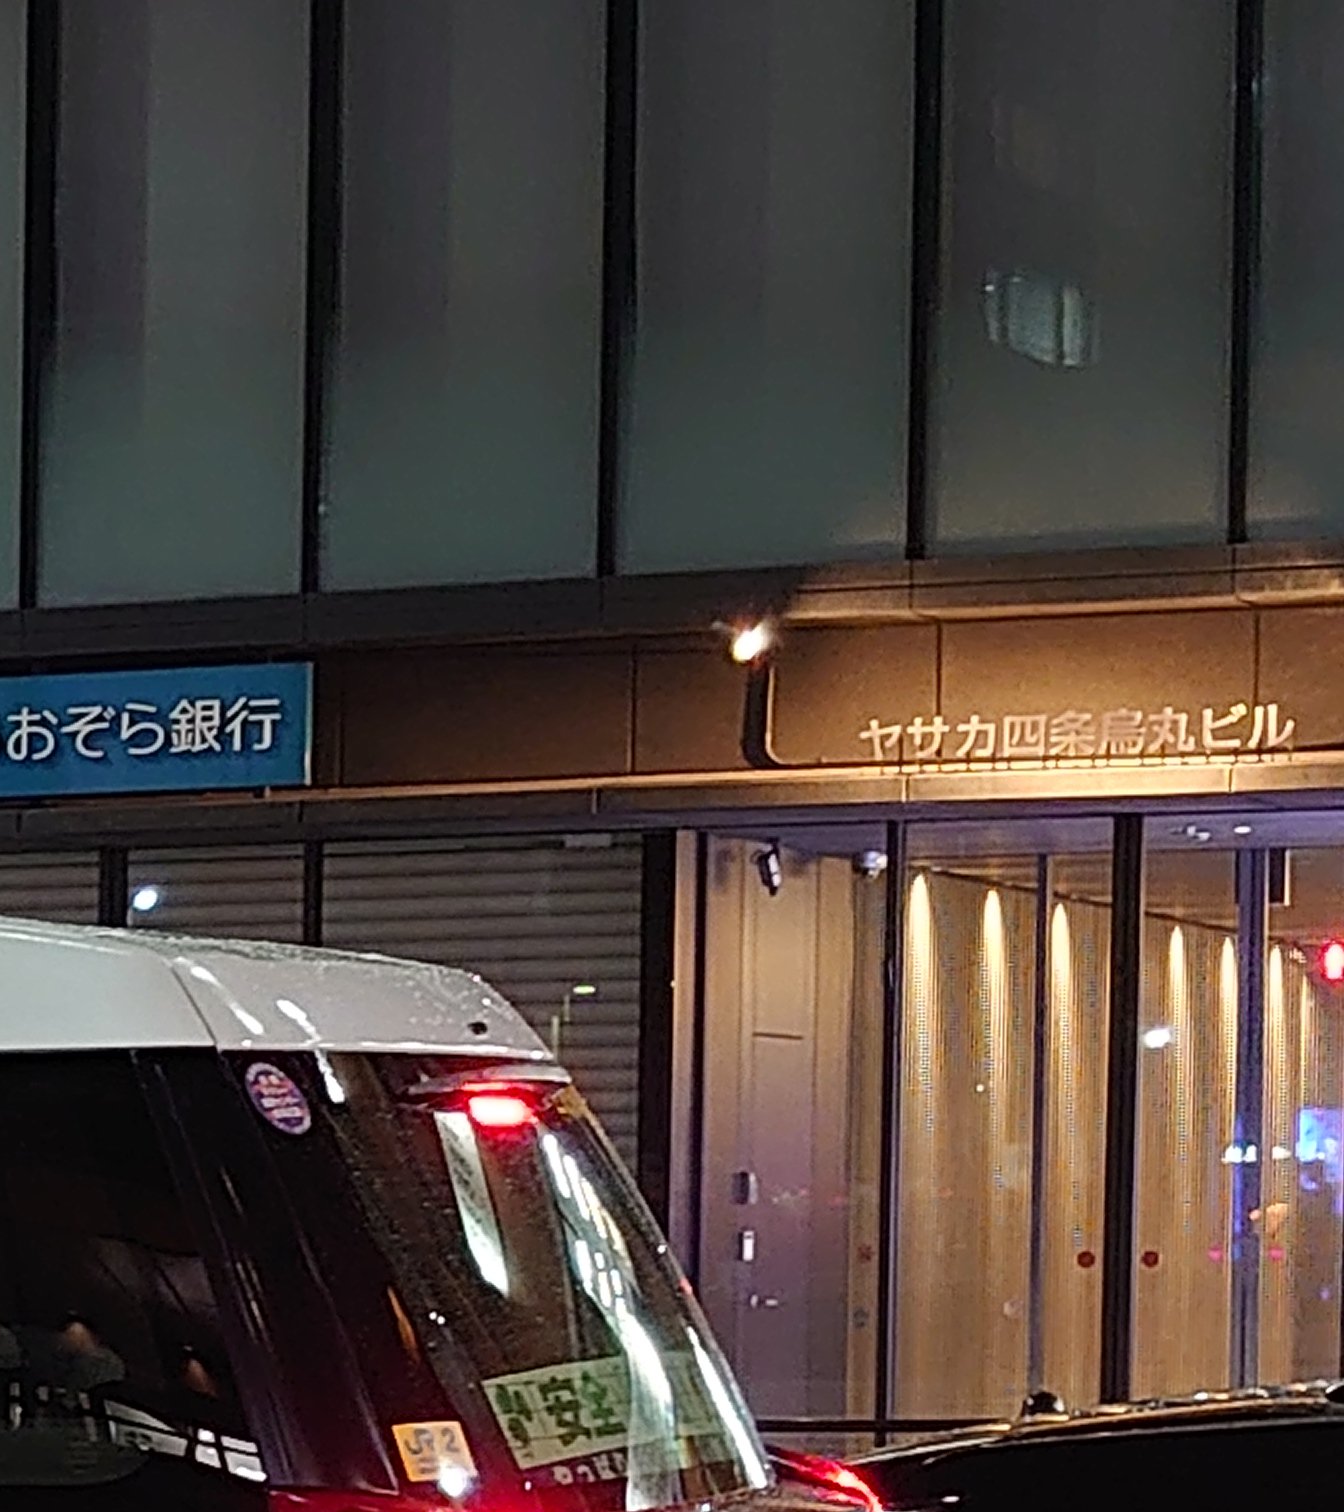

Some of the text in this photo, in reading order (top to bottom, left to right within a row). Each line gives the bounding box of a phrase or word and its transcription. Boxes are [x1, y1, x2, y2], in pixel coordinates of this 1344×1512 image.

[859, 703, 1296, 760] ヤサカ四条烏丸ビル
